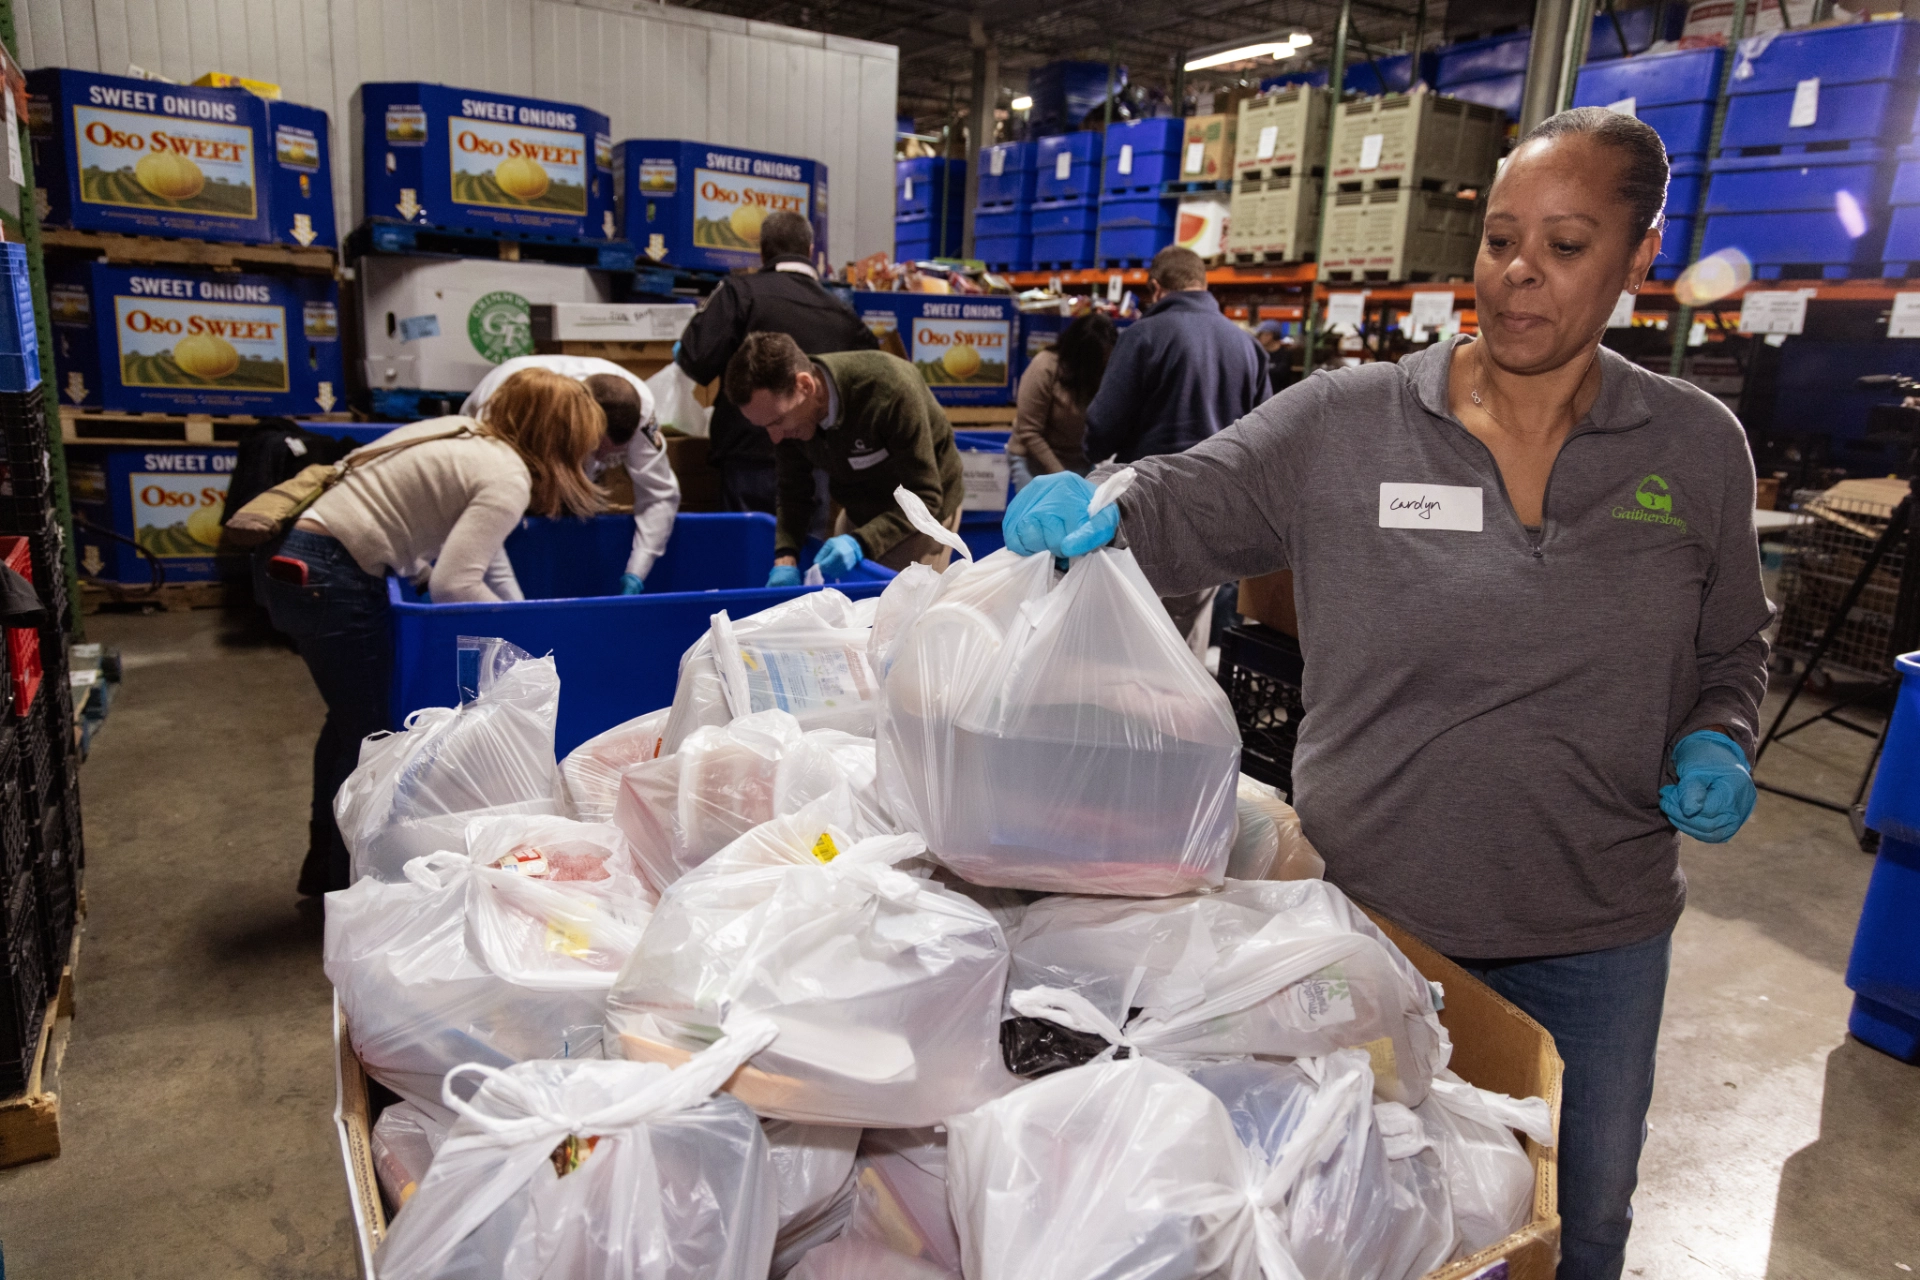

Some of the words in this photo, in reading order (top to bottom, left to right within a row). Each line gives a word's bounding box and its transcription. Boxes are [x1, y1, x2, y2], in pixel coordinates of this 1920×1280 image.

[89, 85, 157, 112] SWEET
[163, 95, 237, 122] ONIONS
[462, 98, 516, 122] SWEET
[519, 106, 577, 130] ONIONS
[706, 152, 752, 173] SWEET
[753, 159, 802, 181] ONIONS
[129, 276, 195, 298] SWEET
[200, 281, 271, 303] ONIONS
[923, 302, 961, 317] SWEET
[962, 304, 1004, 319] ONIONS
[144, 453, 208, 471] SWEET
[1389, 495, 1441, 519] Carolyn
[1612, 506, 1687, 534] Gaithersburg
